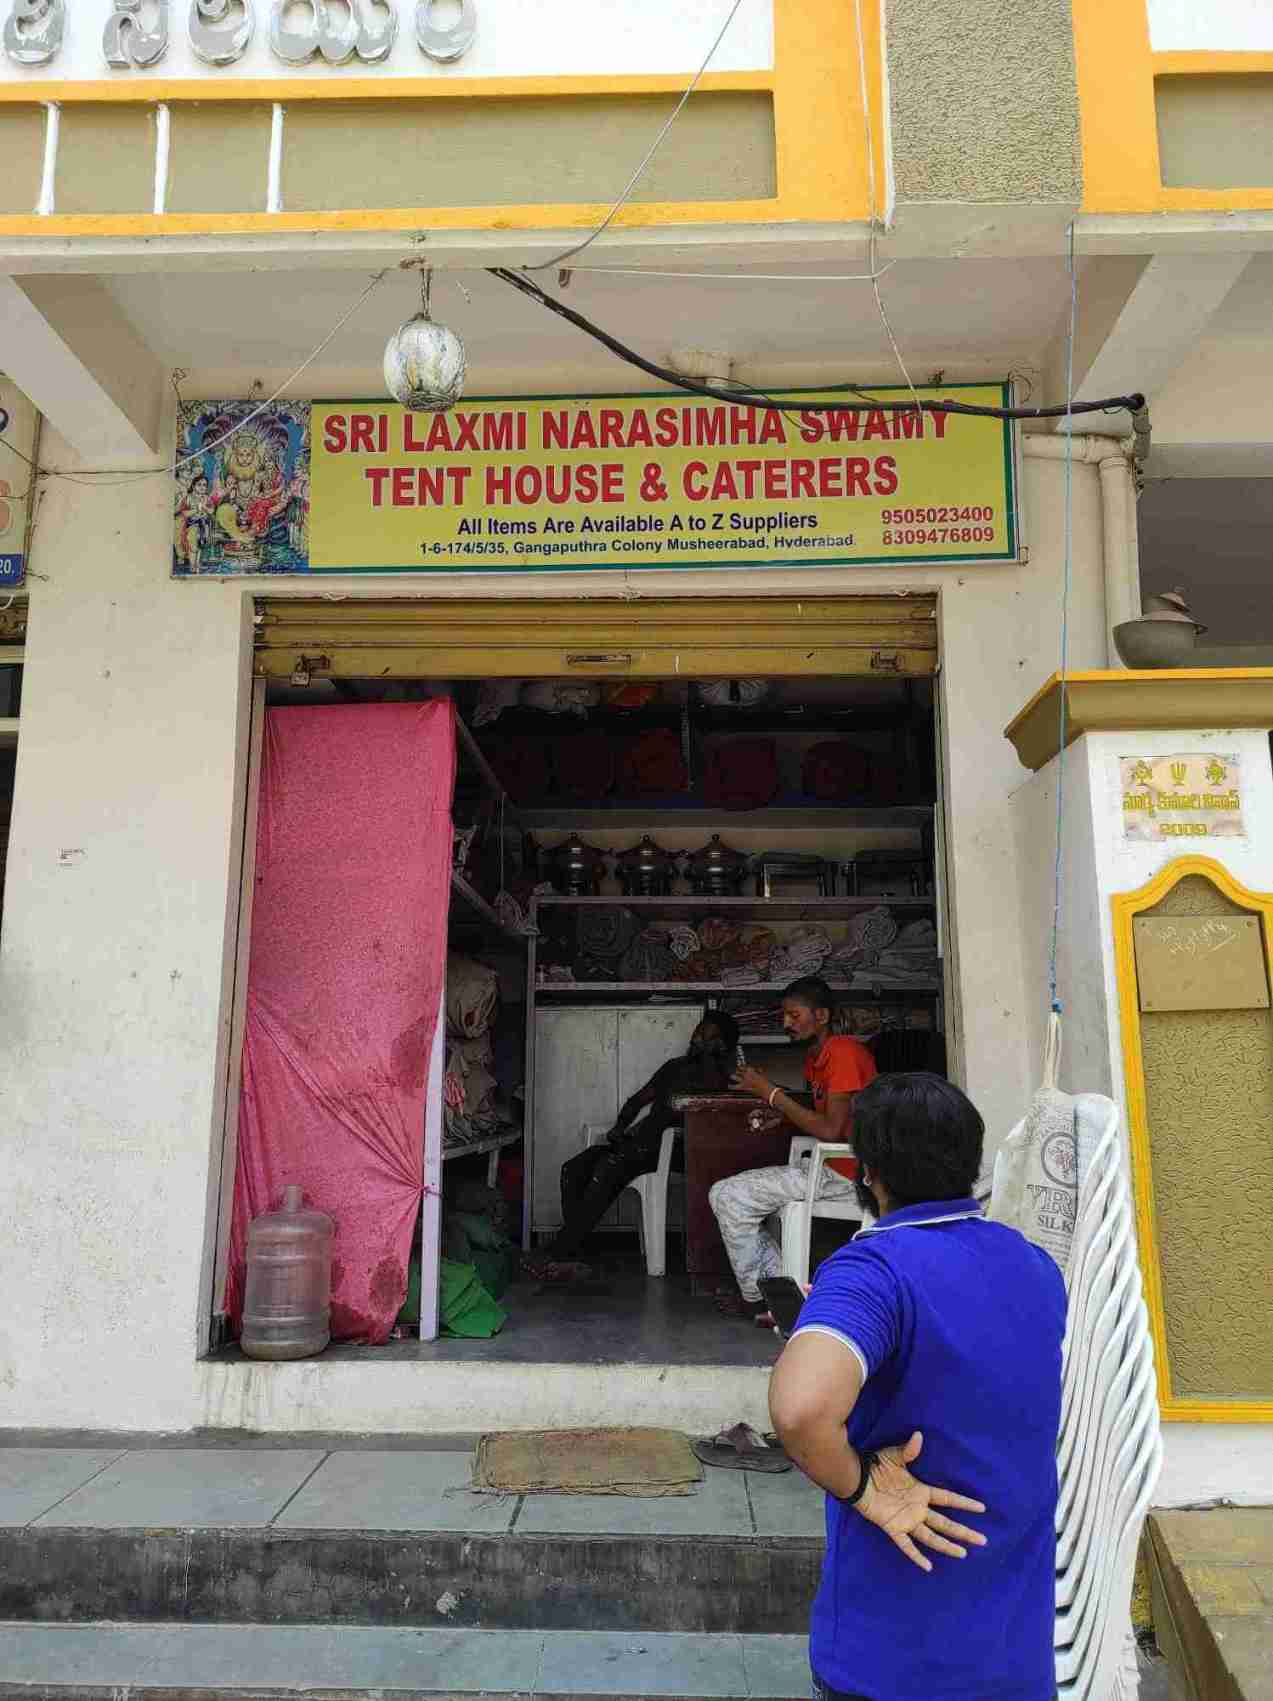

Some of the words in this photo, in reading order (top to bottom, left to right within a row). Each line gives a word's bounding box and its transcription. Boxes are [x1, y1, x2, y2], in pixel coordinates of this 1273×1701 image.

[324, 415, 388, 453] SRI
[403, 412, 527, 452] LAXMI
[542, 406, 788, 449] NARASIMHA
[800, 399, 949, 444] SWAMY
[365, 467, 471, 506] TENT
[485, 463, 625, 505] HOUSE
[639, 462, 668, 503] &
[682, 455, 898, 501] CATERERS
[457, 518, 481, 535] All
[488, 517, 537, 534] Items
[543, 517, 574, 533] Are
[580, 515, 665, 533] Available
[669, 515, 683, 531] A
[689, 514, 706, 530] to
[711, 513, 724, 530] Z
[730, 511, 818, 533] Suppliers
[881, 506, 993, 524] 9505023400
[420, 541, 509, 555] 1-6-174/5/35,
[513, 540, 607, 556] Gangaputhra
[611, 538, 662, 554] Colony
[667, 537, 769, 551] Musheerabad,
[774, 534, 854, 549] Hyderabad
[882, 527, 994, 545] 8309476809
